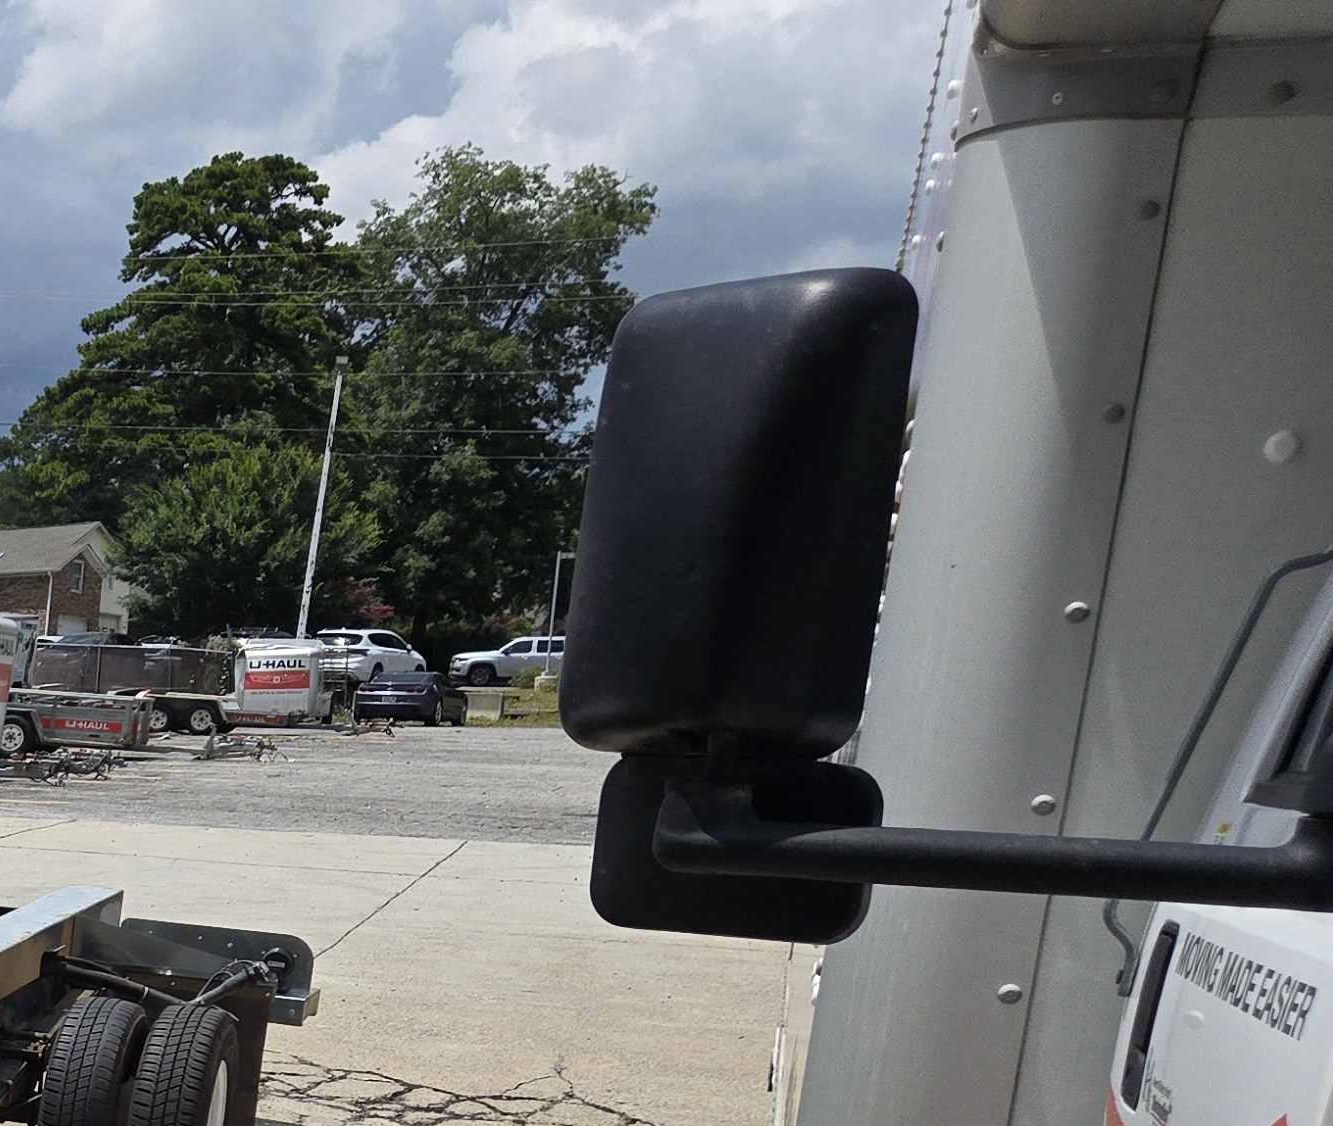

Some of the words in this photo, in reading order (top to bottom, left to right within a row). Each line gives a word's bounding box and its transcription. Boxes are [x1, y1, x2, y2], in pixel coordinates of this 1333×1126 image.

[249, 659, 307, 669] U-HAUL
[65, 719, 111, 730] U-HAUL
[1175, 931, 1225, 994] MOVING
[1214, 951, 1264, 1013] MADE
[1252, 968, 1318, 1041] EASIER
